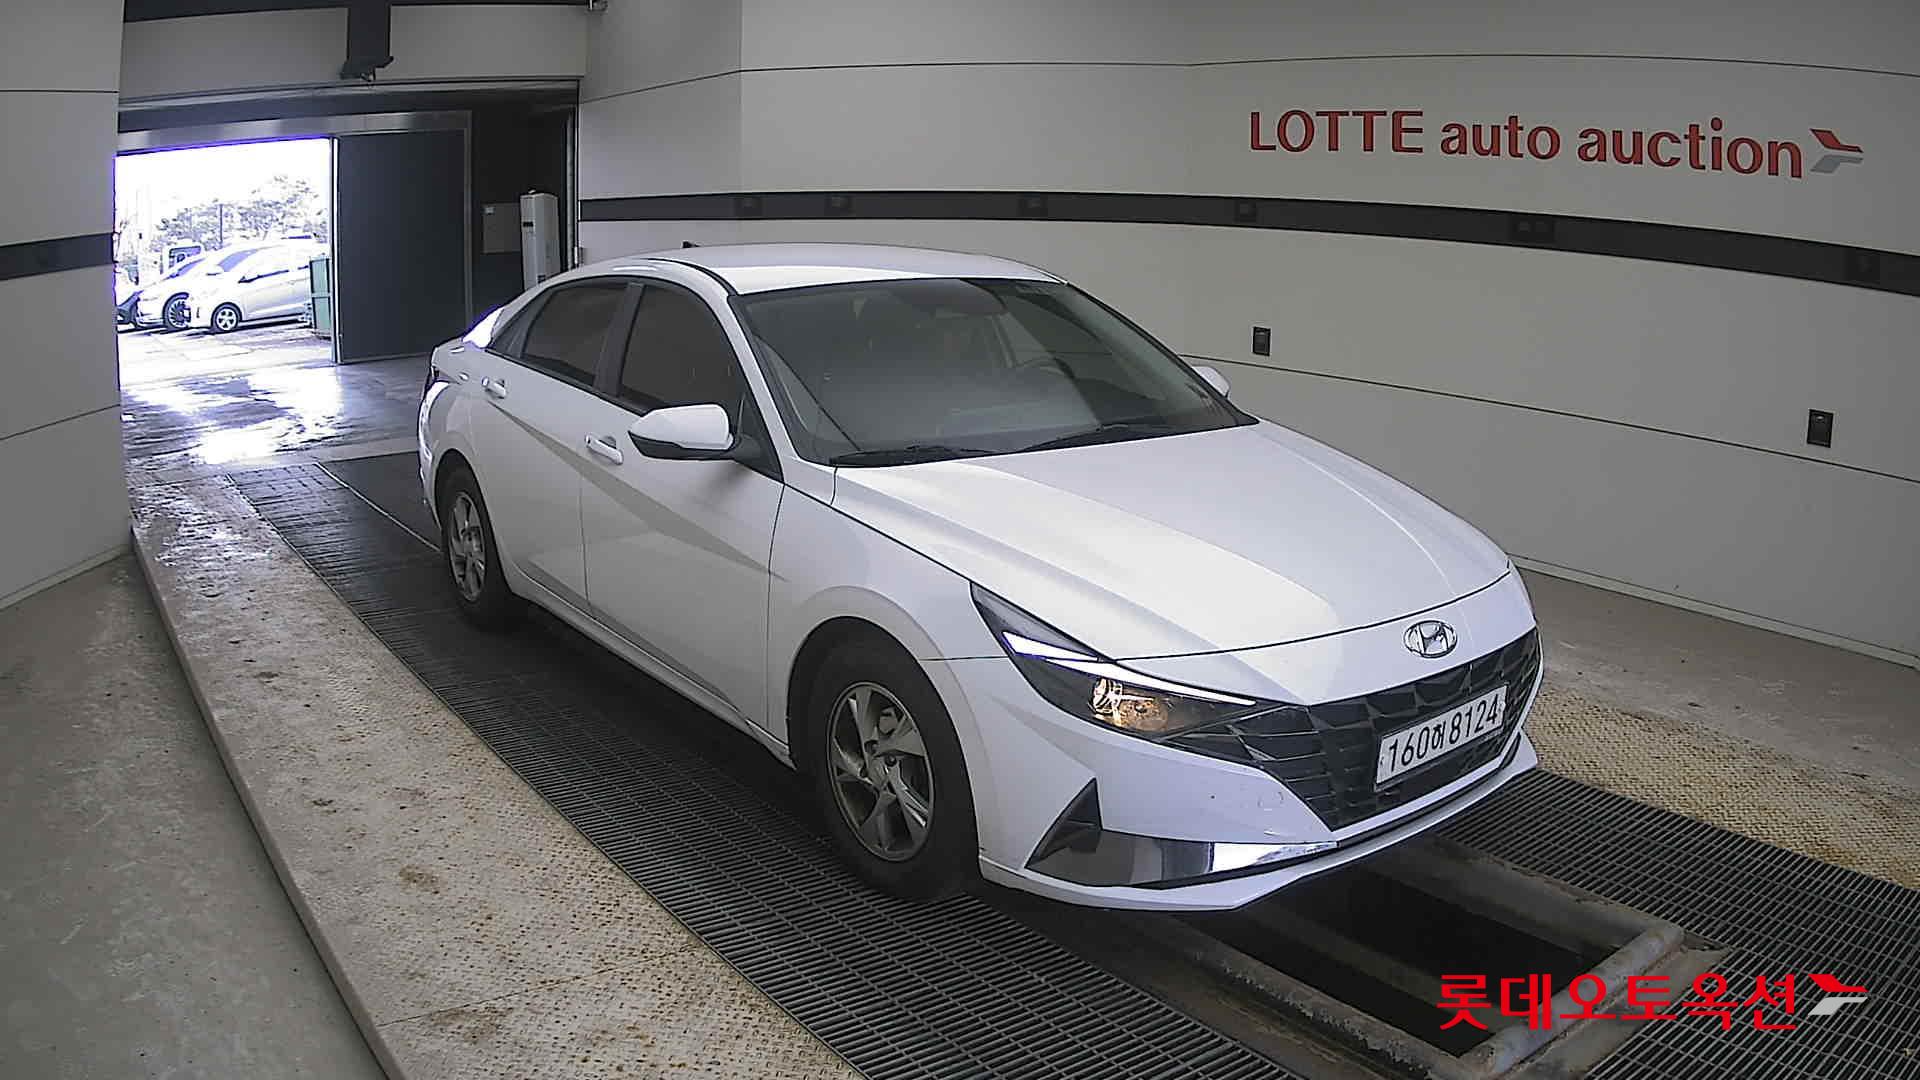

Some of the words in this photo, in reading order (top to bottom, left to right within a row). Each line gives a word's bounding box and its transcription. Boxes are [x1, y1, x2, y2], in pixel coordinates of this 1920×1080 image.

[1250, 109, 1424, 154] LOTTE
[1440, 114, 1561, 160] auto
[1577, 116, 1803, 179] auction
